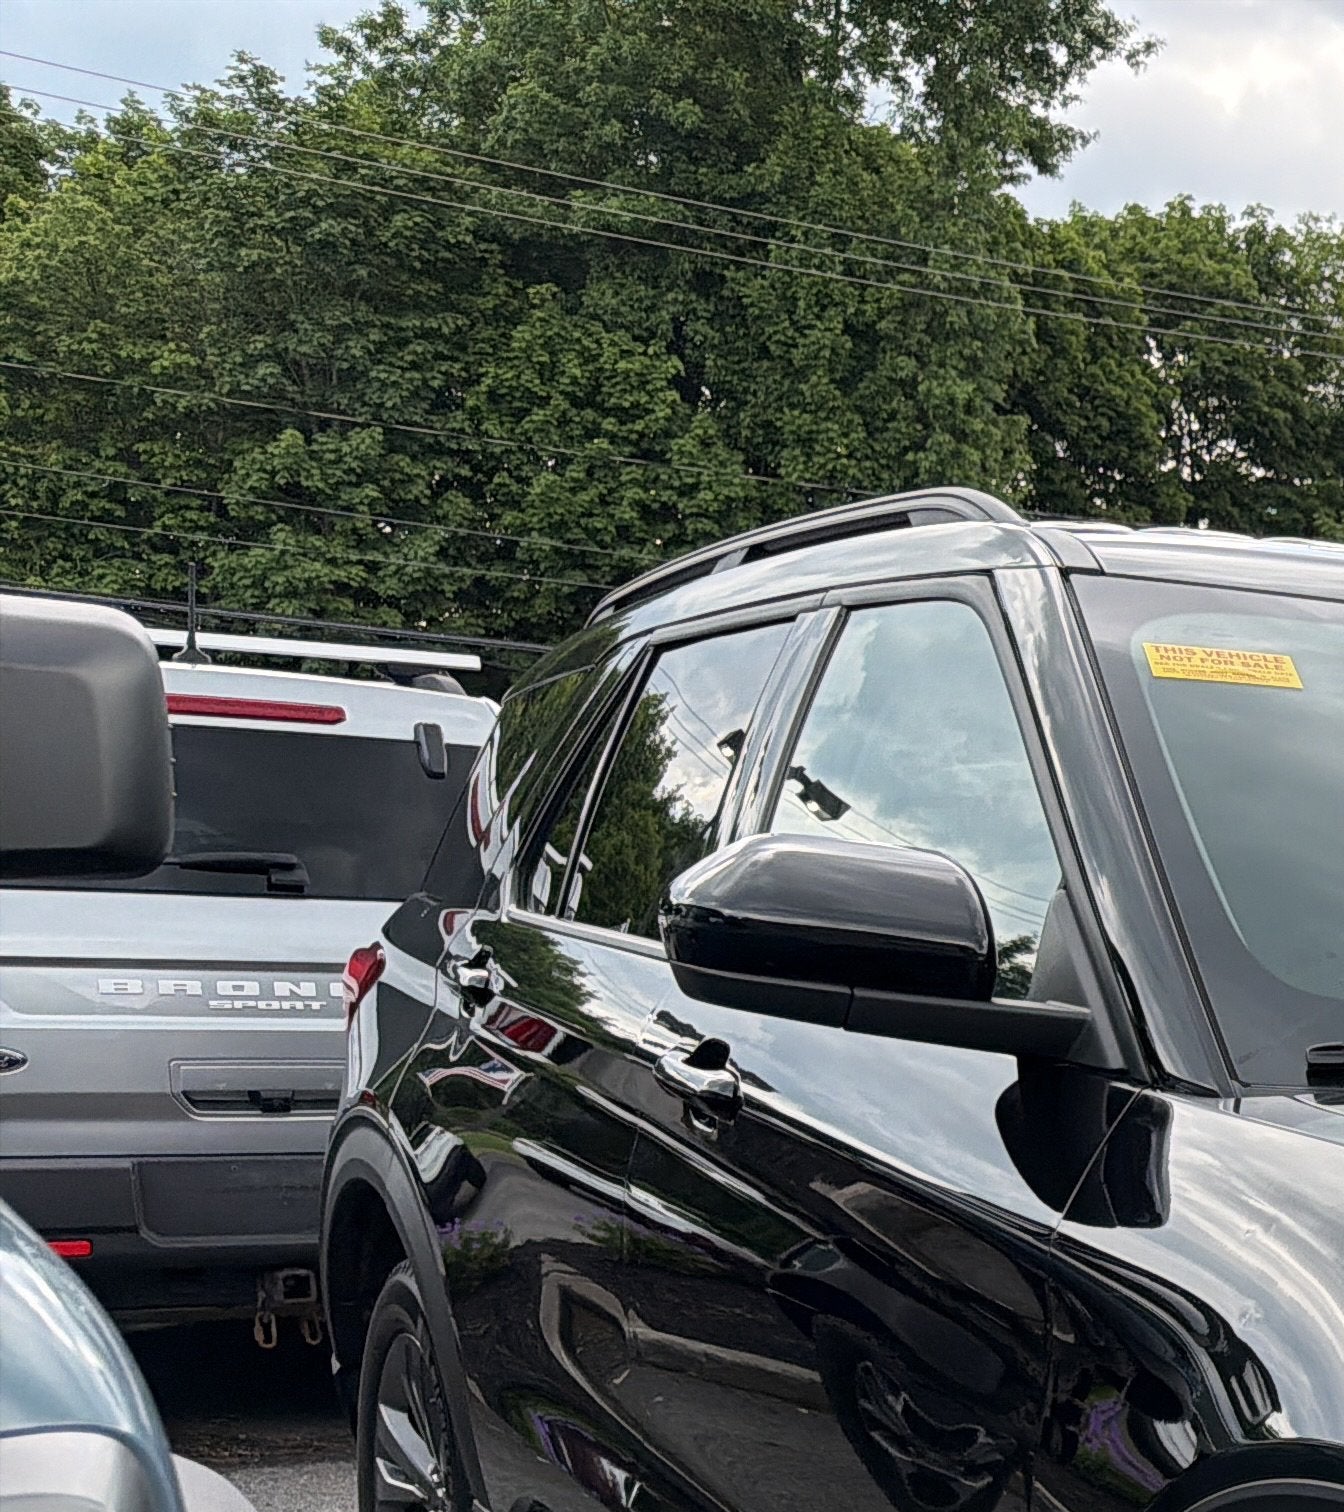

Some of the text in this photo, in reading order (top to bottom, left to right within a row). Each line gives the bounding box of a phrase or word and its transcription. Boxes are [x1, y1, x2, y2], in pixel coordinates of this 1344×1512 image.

[1151, 645, 1286, 665] THIS VEHICLE
[1159, 654, 1286, 671] NOT FOR SALE
[208, 999, 327, 1010] SPORT
